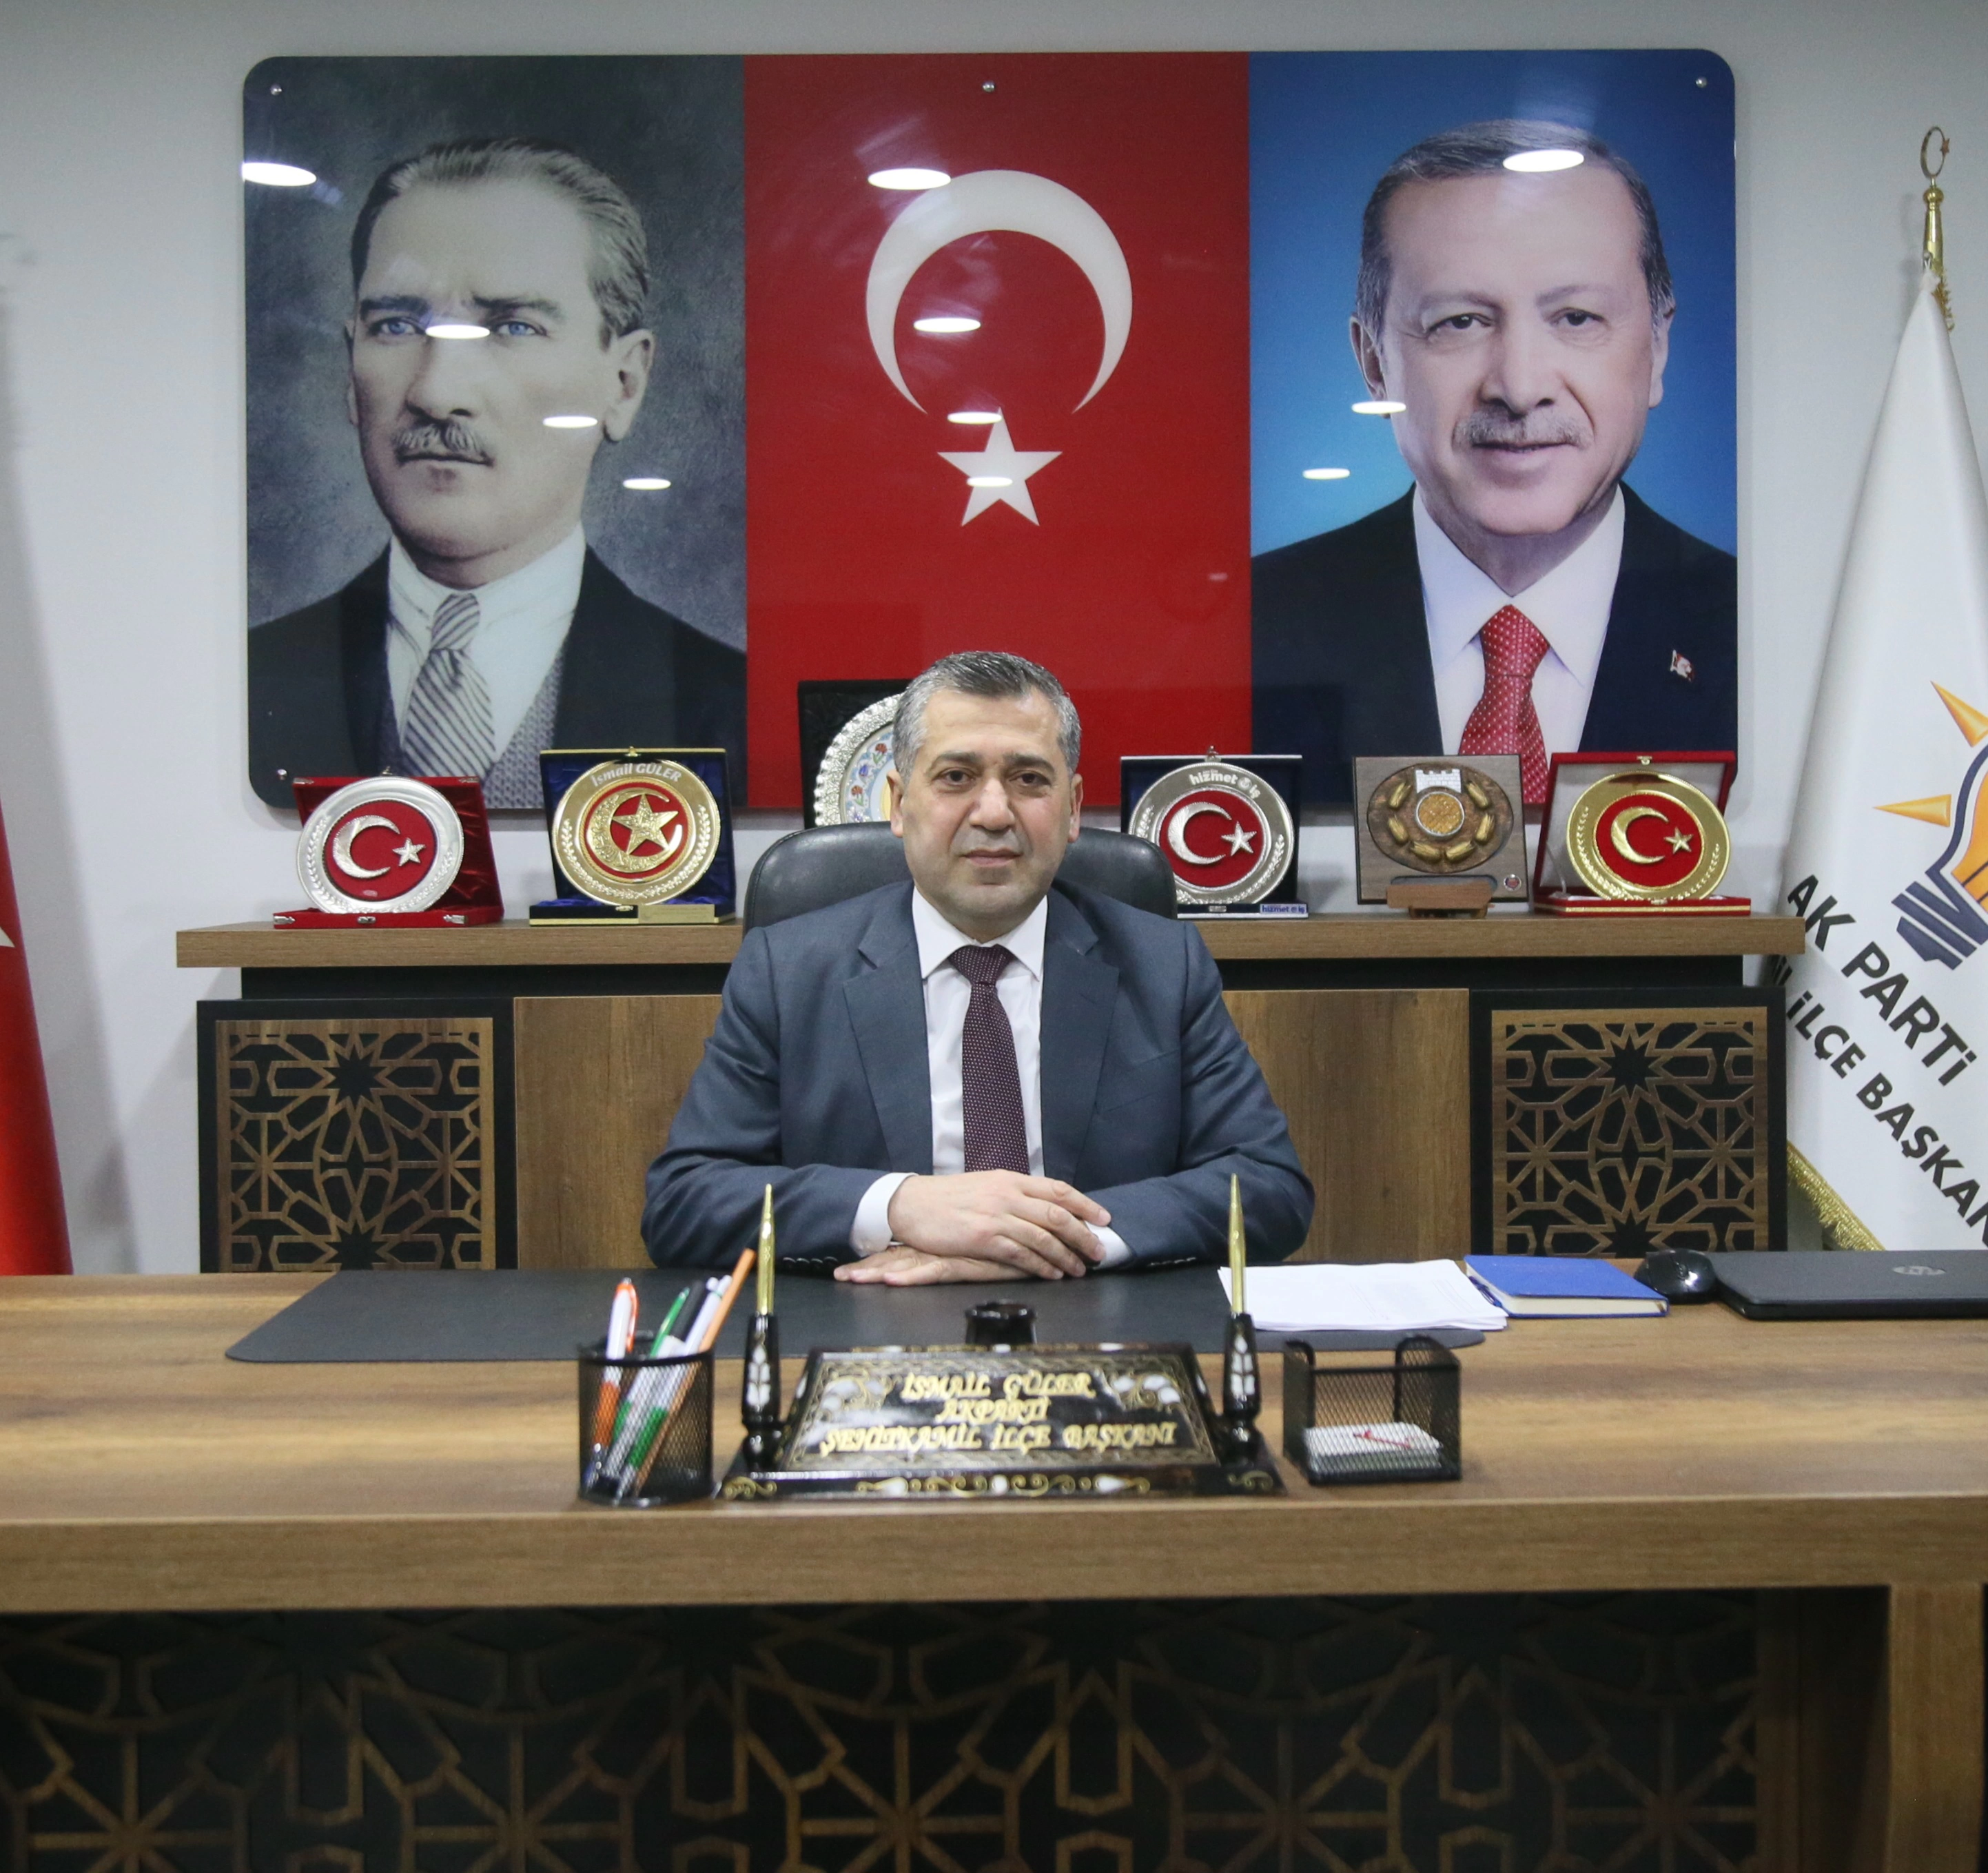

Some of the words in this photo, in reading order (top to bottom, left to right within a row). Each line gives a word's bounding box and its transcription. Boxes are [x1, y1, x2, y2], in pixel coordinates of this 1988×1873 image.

[635, 762, 682, 782] GÜLER
[1189, 771, 1238, 786] hizmet
[1787, 874, 1856, 952] AK
